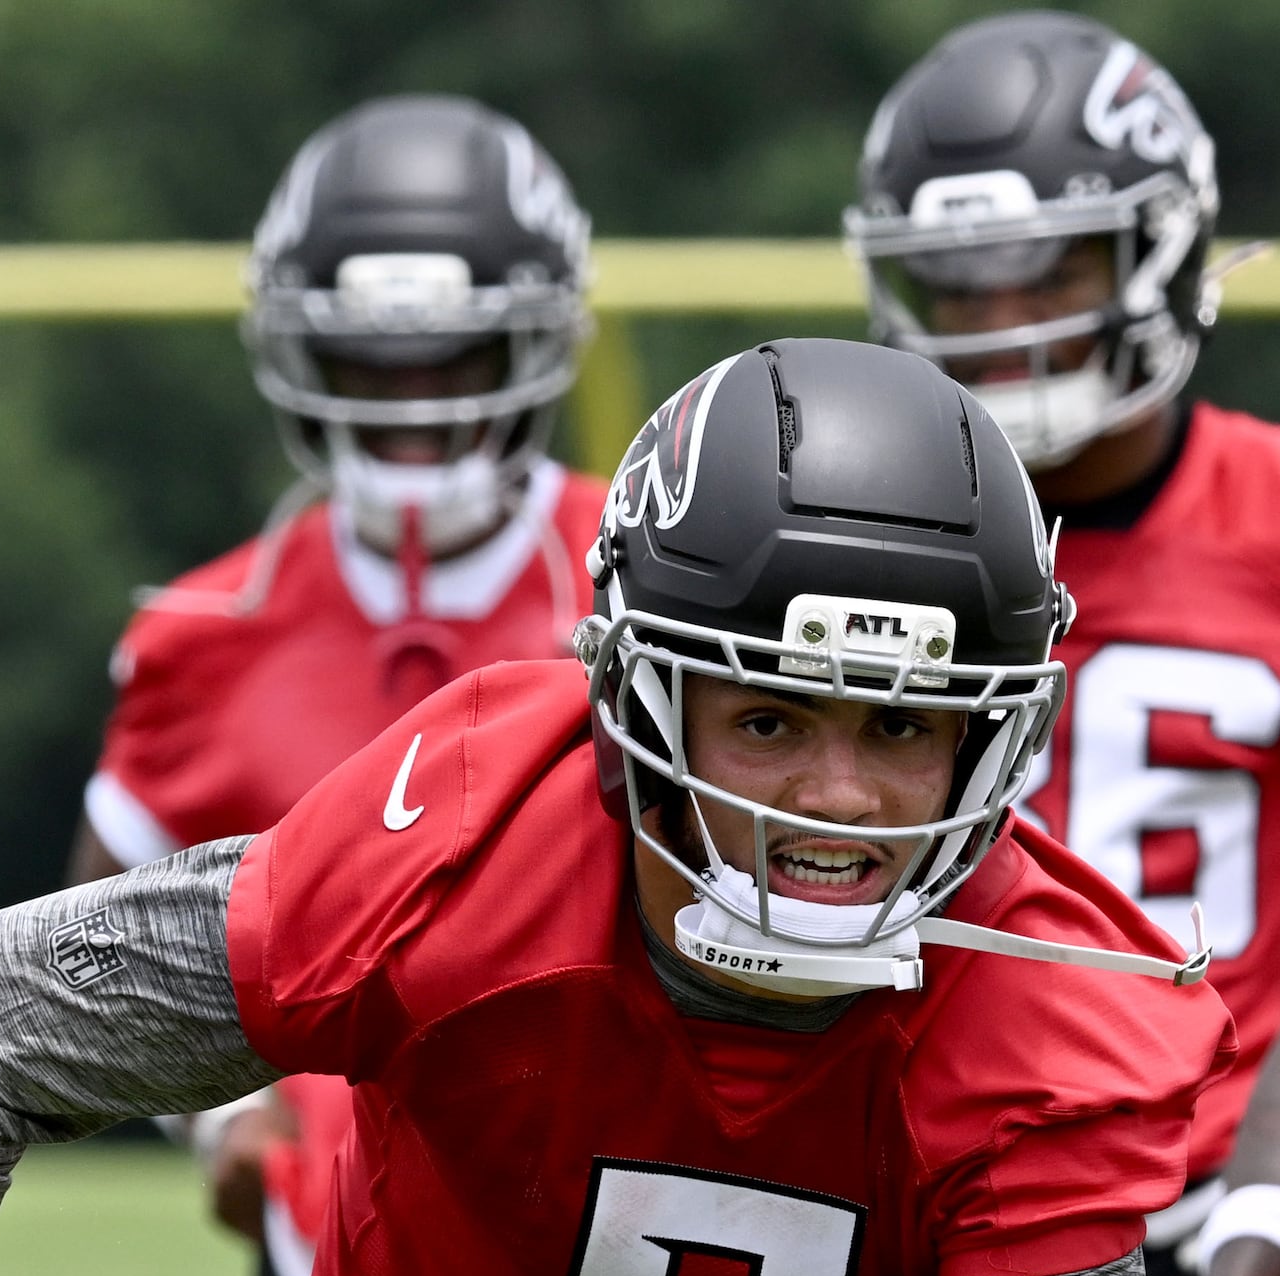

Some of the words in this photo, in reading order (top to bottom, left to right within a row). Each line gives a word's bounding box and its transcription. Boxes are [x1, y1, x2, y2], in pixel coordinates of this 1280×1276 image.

[843, 611, 909, 638] ATL
[55, 923, 96, 982] NFL
[704, 947, 766, 972] SPORT
